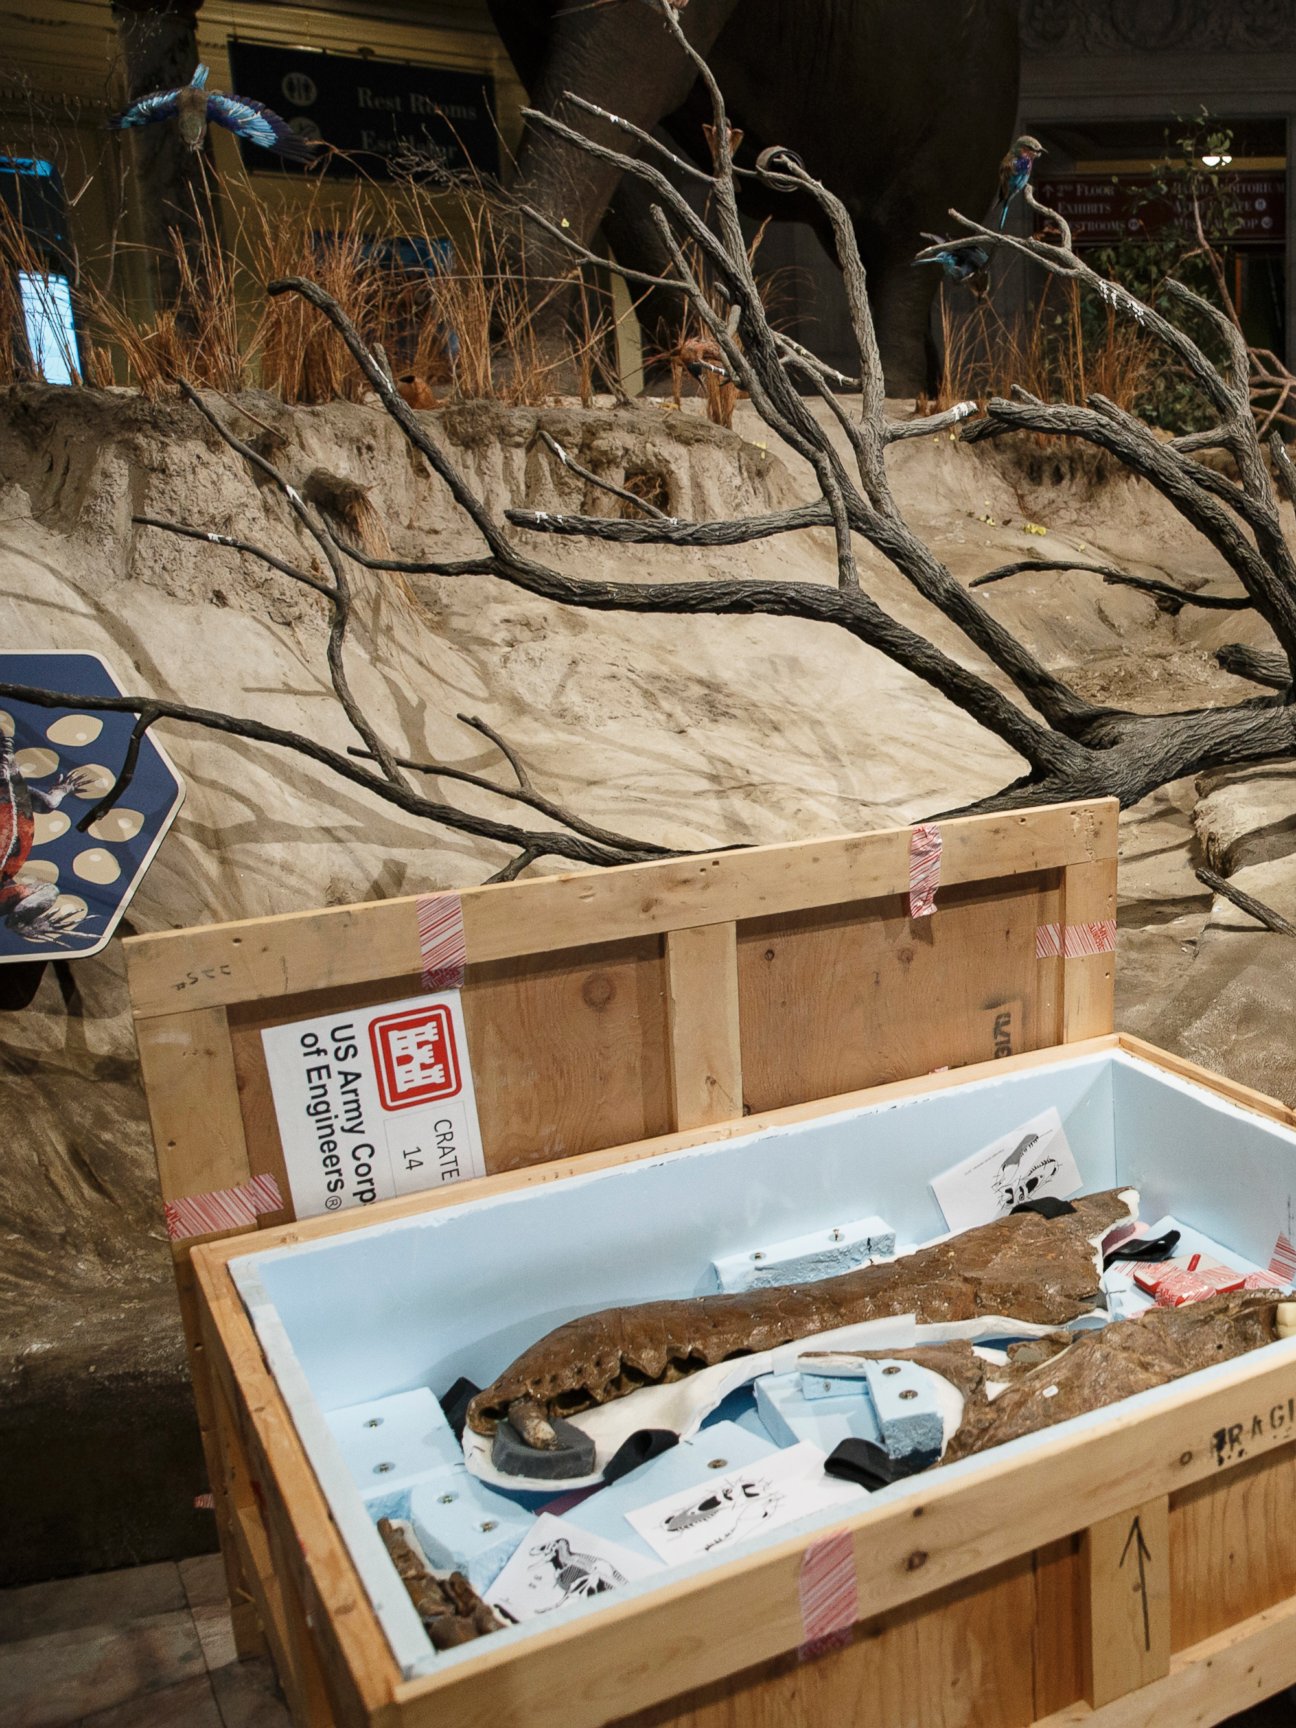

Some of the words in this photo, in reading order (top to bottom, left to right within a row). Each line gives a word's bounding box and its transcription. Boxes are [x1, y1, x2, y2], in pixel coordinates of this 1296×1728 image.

[357, 86, 402, 113] Rest
[409, 92, 478, 120] Rooms
[360, 129, 459, 160] Esclator
[1057, 201, 1112, 214] EXHIBITS
[1067, 219, 1126, 232] ESTROOMS
[300, 1032, 328, 1057] of
[330, 1023, 358, 1062] US
[337, 1069, 365, 1135] Army
[402, 1146, 424, 1171] 14
[433, 1118, 460, 1181] CRATE
[352, 1142, 377, 1207] Corp
